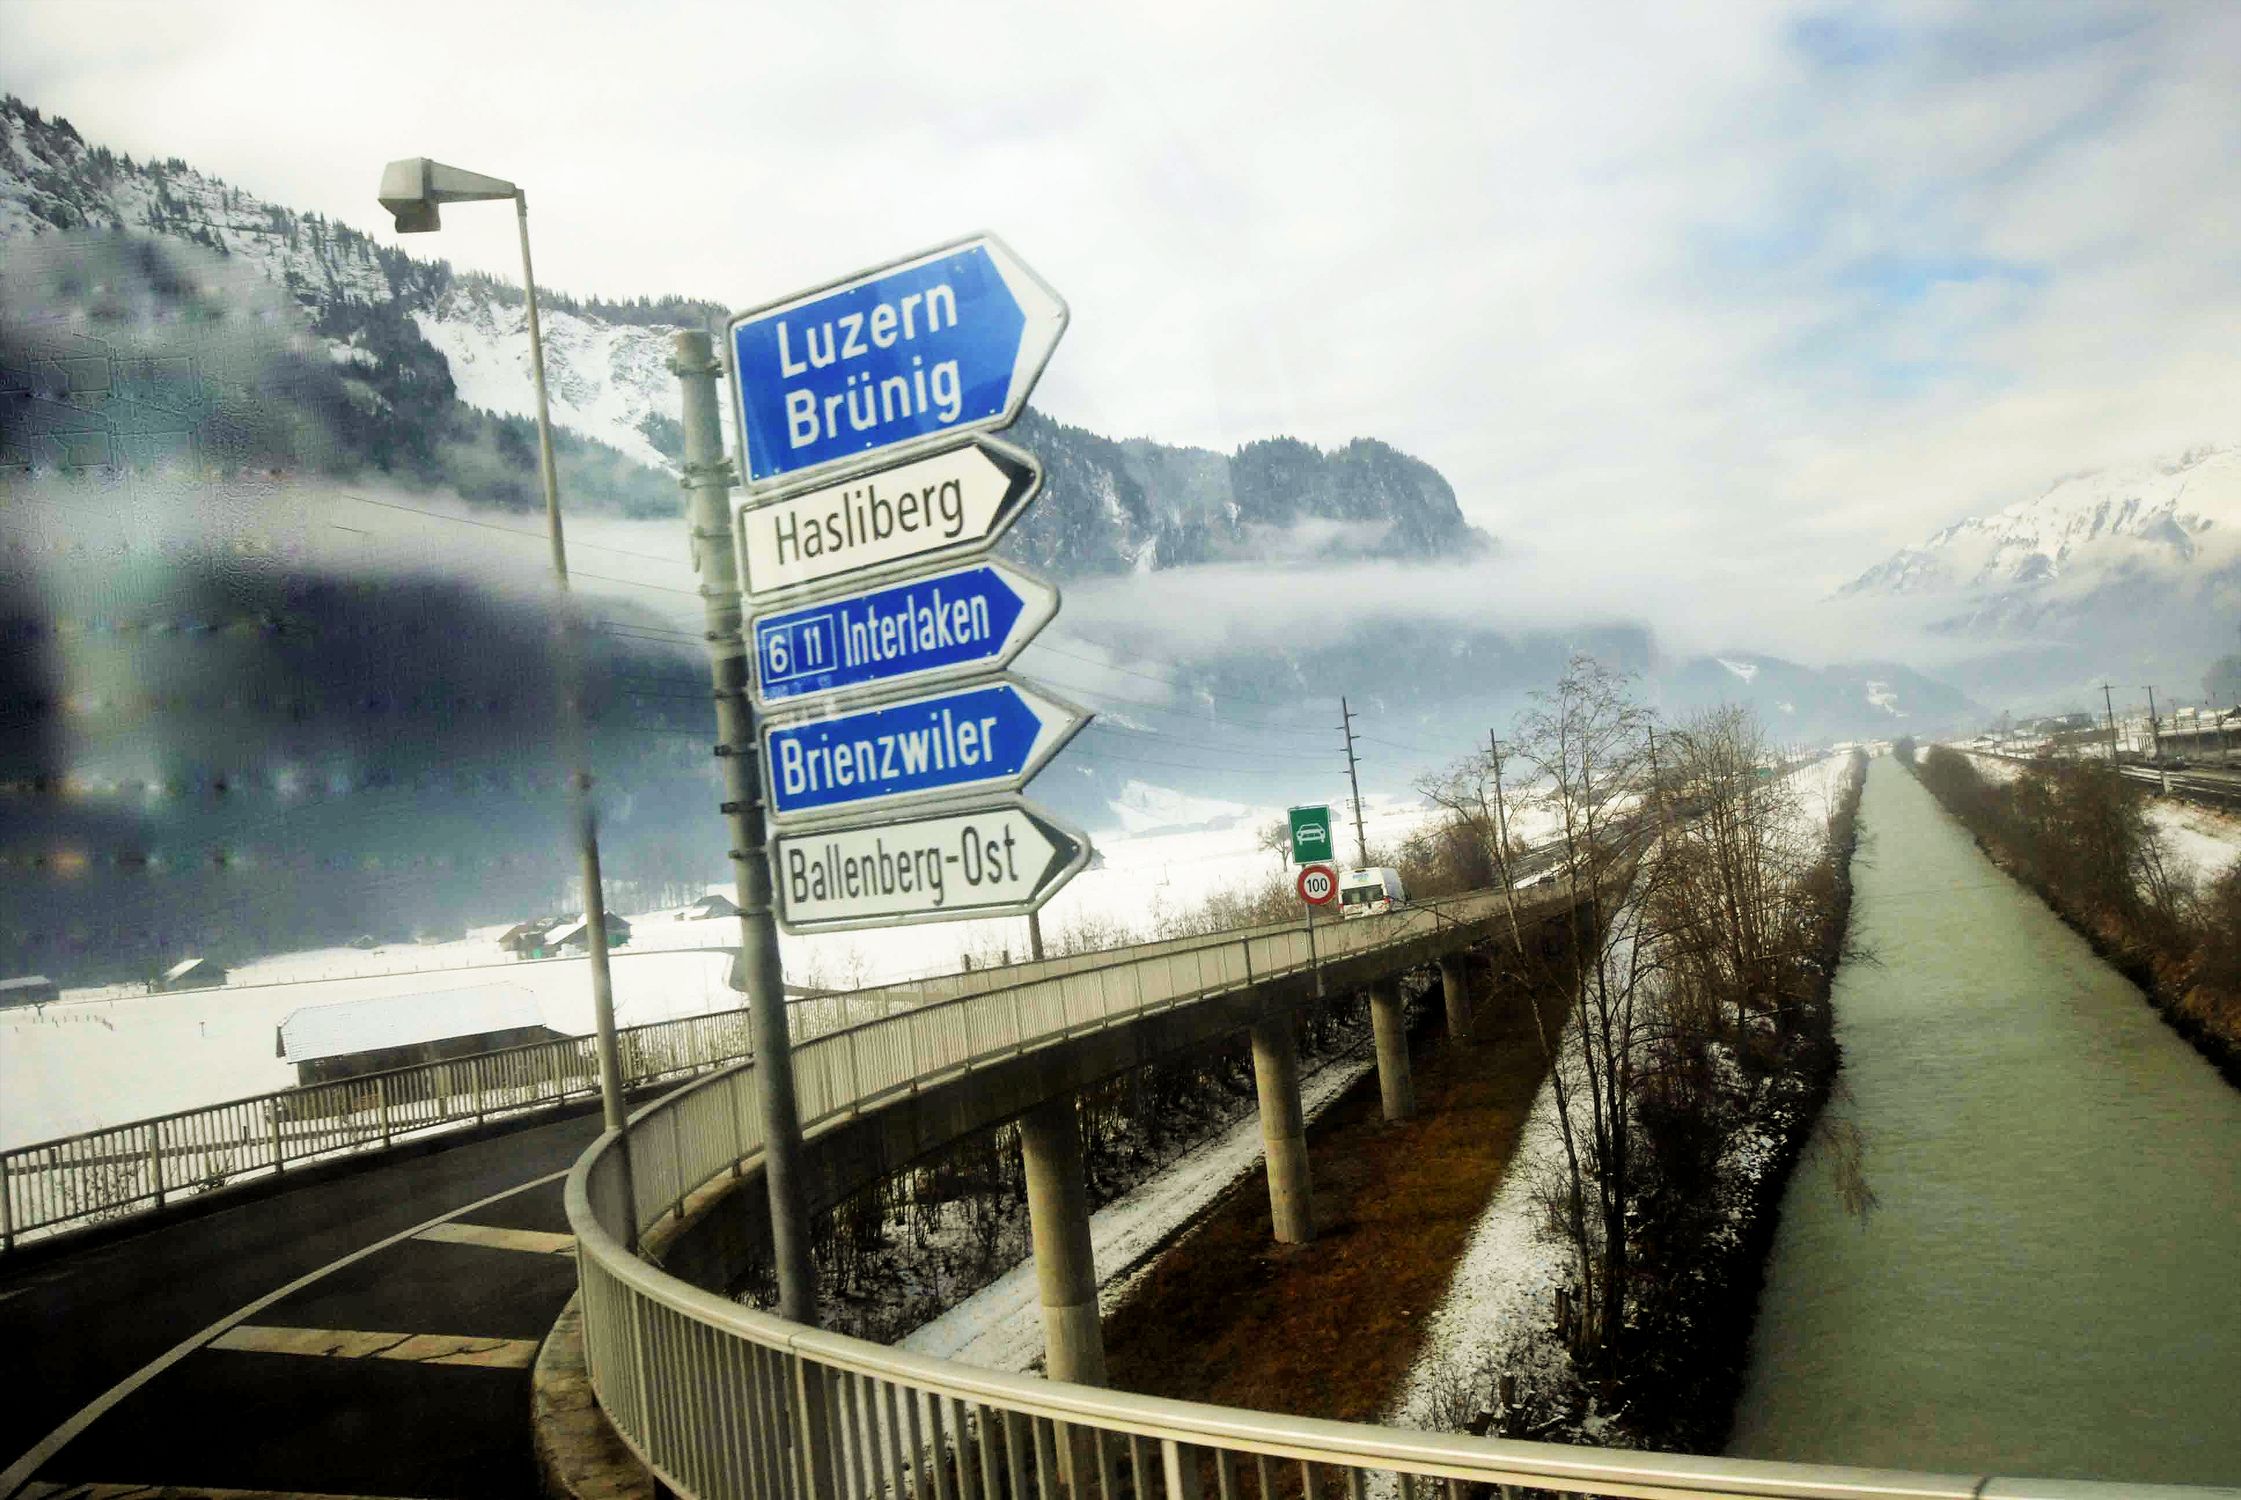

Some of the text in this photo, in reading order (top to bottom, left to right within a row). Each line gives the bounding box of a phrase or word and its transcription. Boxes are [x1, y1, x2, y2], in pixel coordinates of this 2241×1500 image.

[776, 283, 958, 379] Luzern
[785, 356, 962, 449] Brünig
[775, 478, 965, 566] Hasliberg
[767, 588, 990, 674] 6 11 Interlaken
[779, 708, 998, 796] Brienzwiler
[788, 822, 1020, 906] Ballenberg-Ost
[1307, 878, 1328, 893] 100
